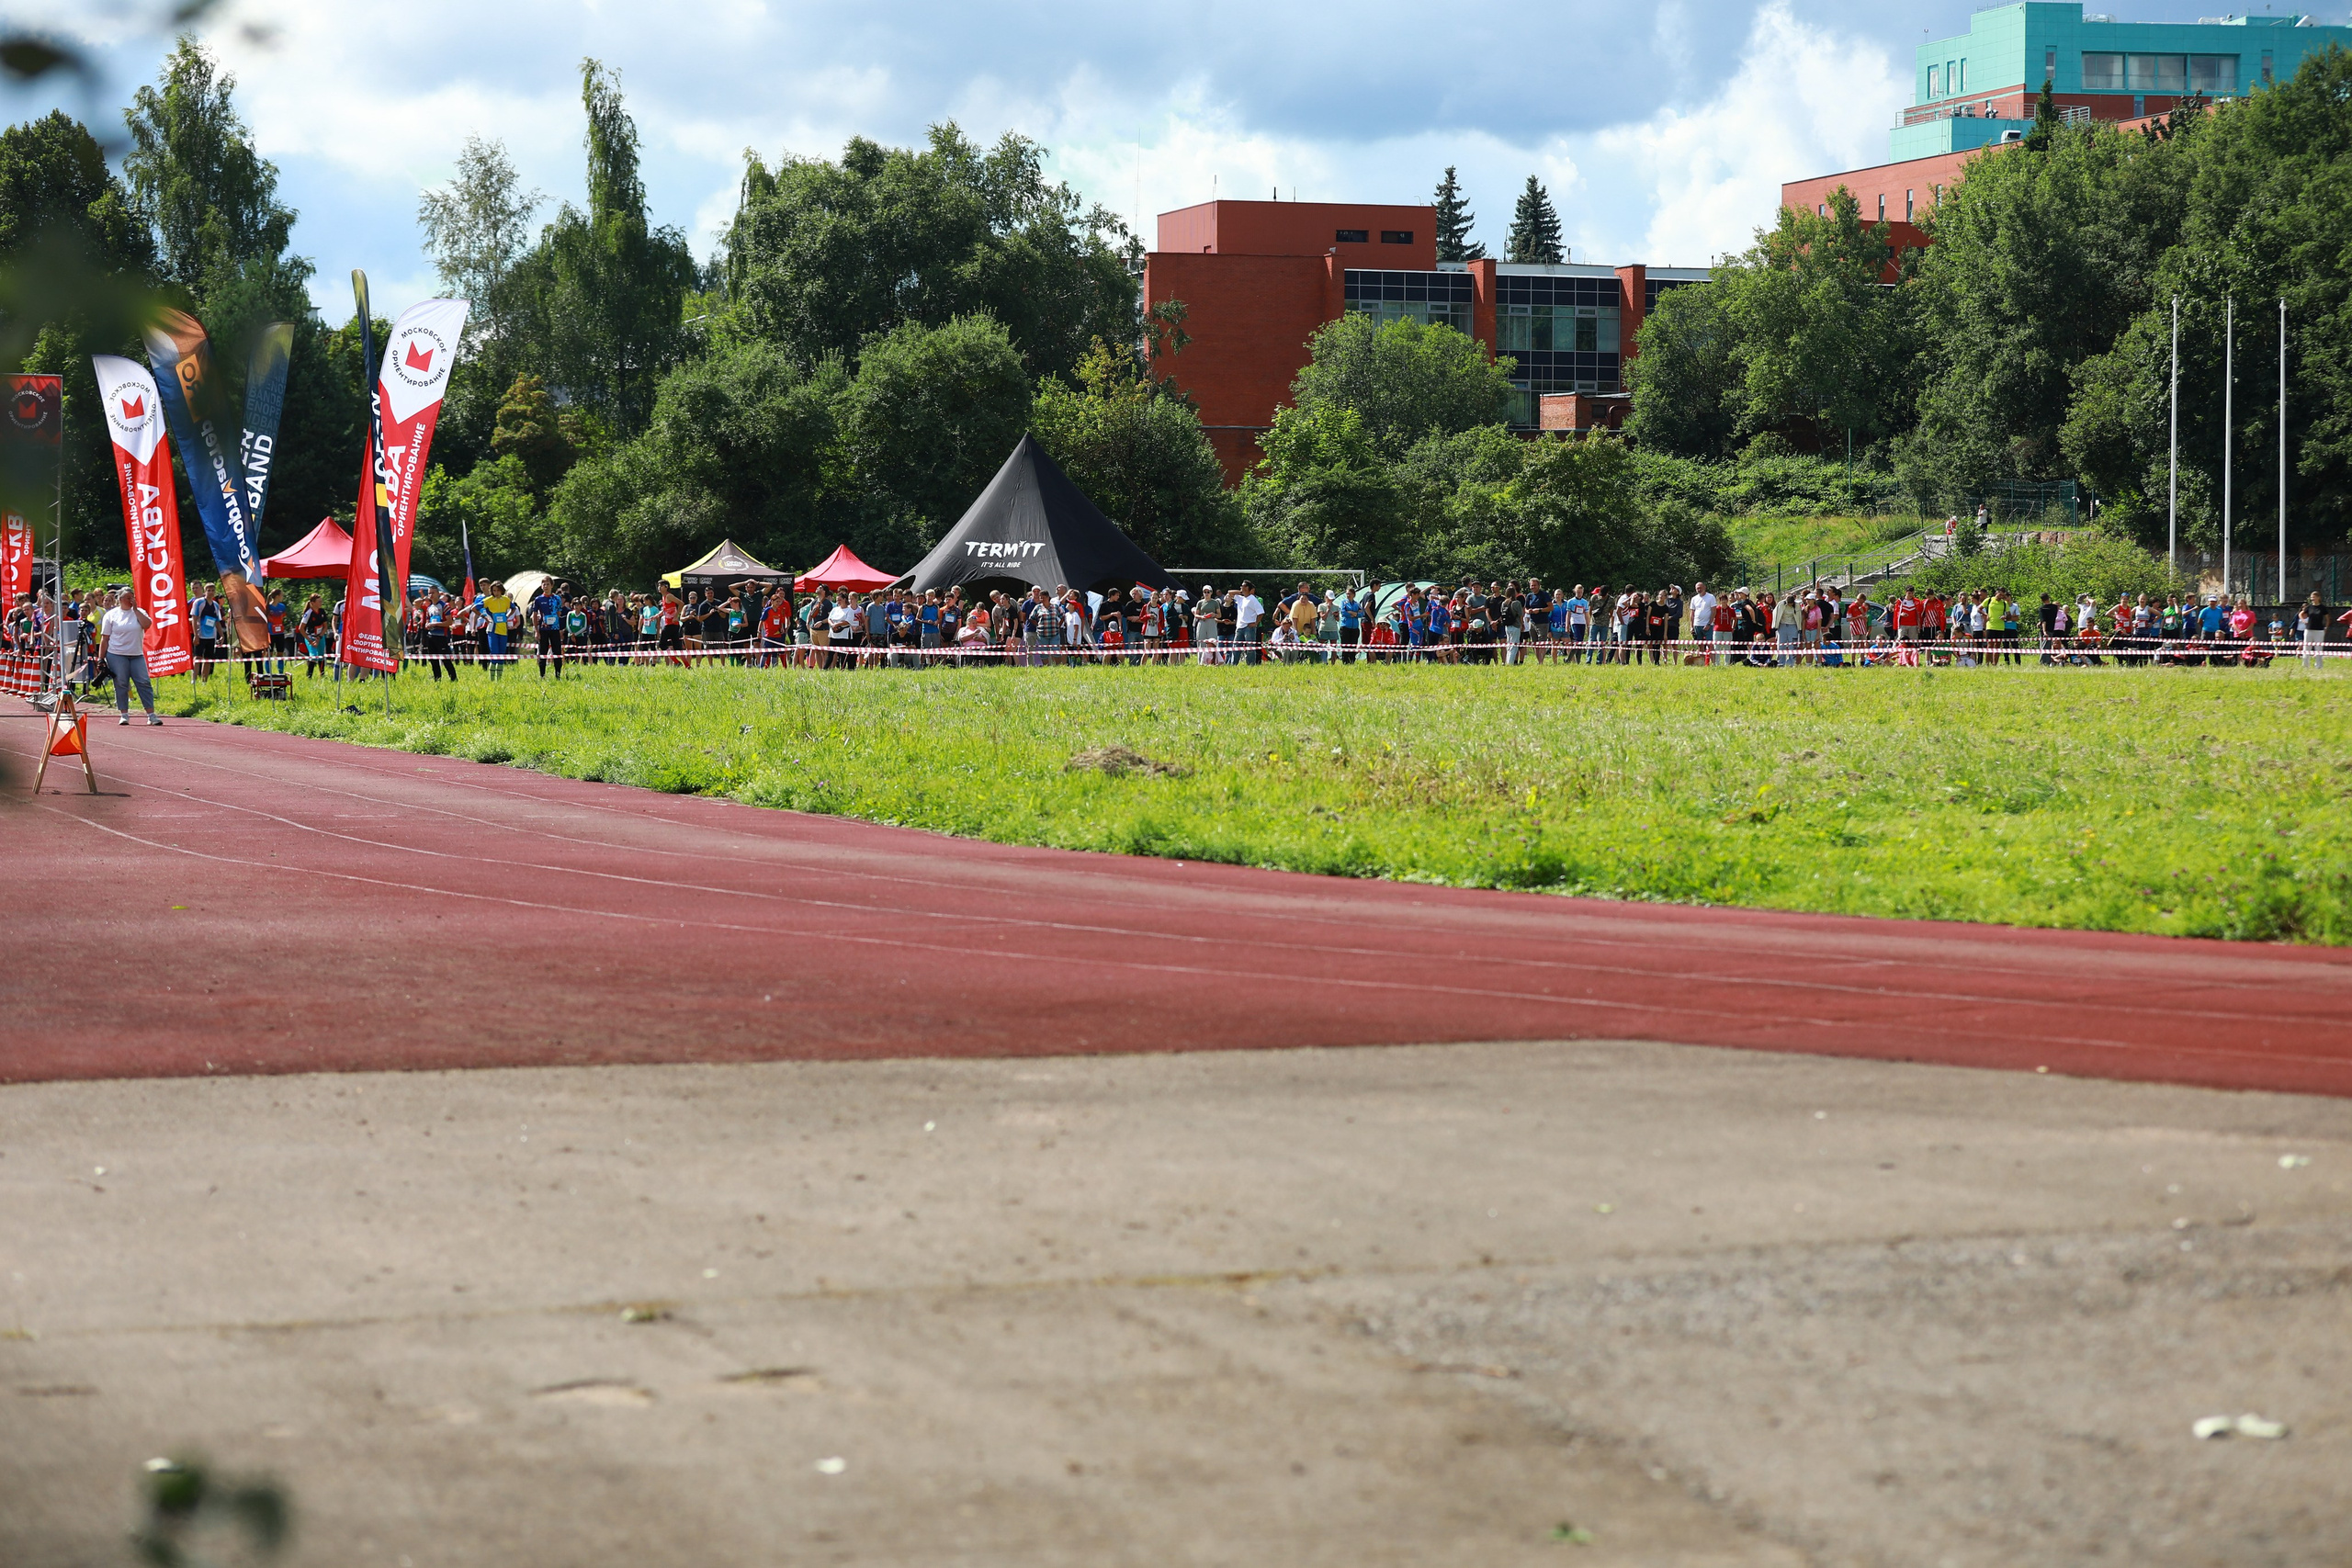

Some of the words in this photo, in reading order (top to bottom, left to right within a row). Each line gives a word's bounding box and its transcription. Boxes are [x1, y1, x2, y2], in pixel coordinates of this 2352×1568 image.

[401, 327, 447, 354] МОСКОВСКОЕ
[392, 350, 446, 387] ОРИЕНТИРОВАНИЕ
[10, 389, 46, 403] МОСКОВСКОЕ
[7, 411, 48, 429] ОРИЕНТИРОВАНИЕ
[245, 434, 273, 509] BAND
[398, 422, 426, 537] ОРИЕНТИРОВАНИЕ
[965, 540, 1046, 558] TERMIT
